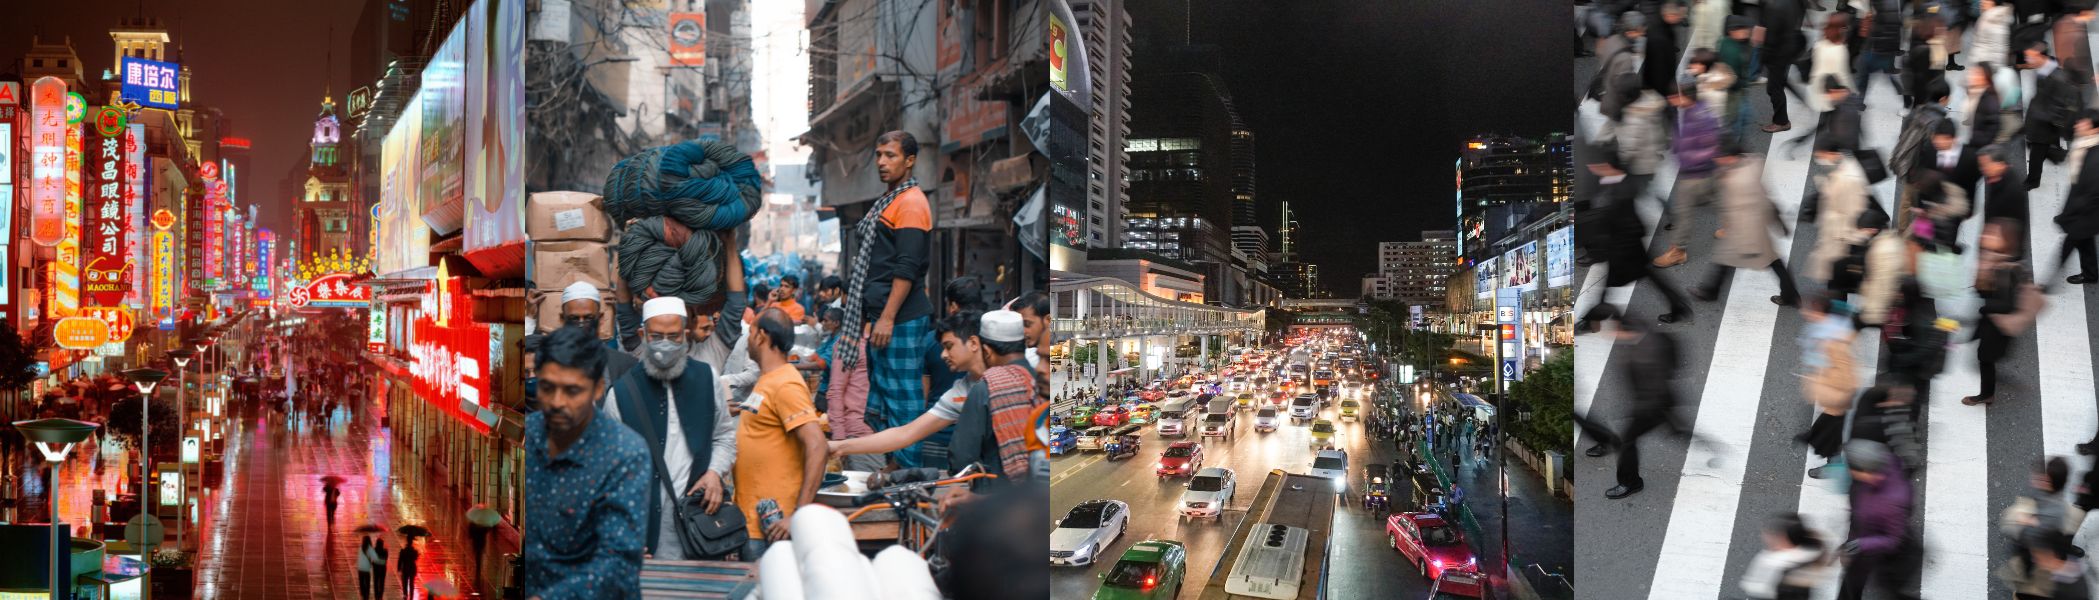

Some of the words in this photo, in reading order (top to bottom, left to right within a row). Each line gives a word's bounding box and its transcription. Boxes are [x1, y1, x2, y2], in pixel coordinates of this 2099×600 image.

[101, 137, 121, 256] 茂昌眼鏡公司
